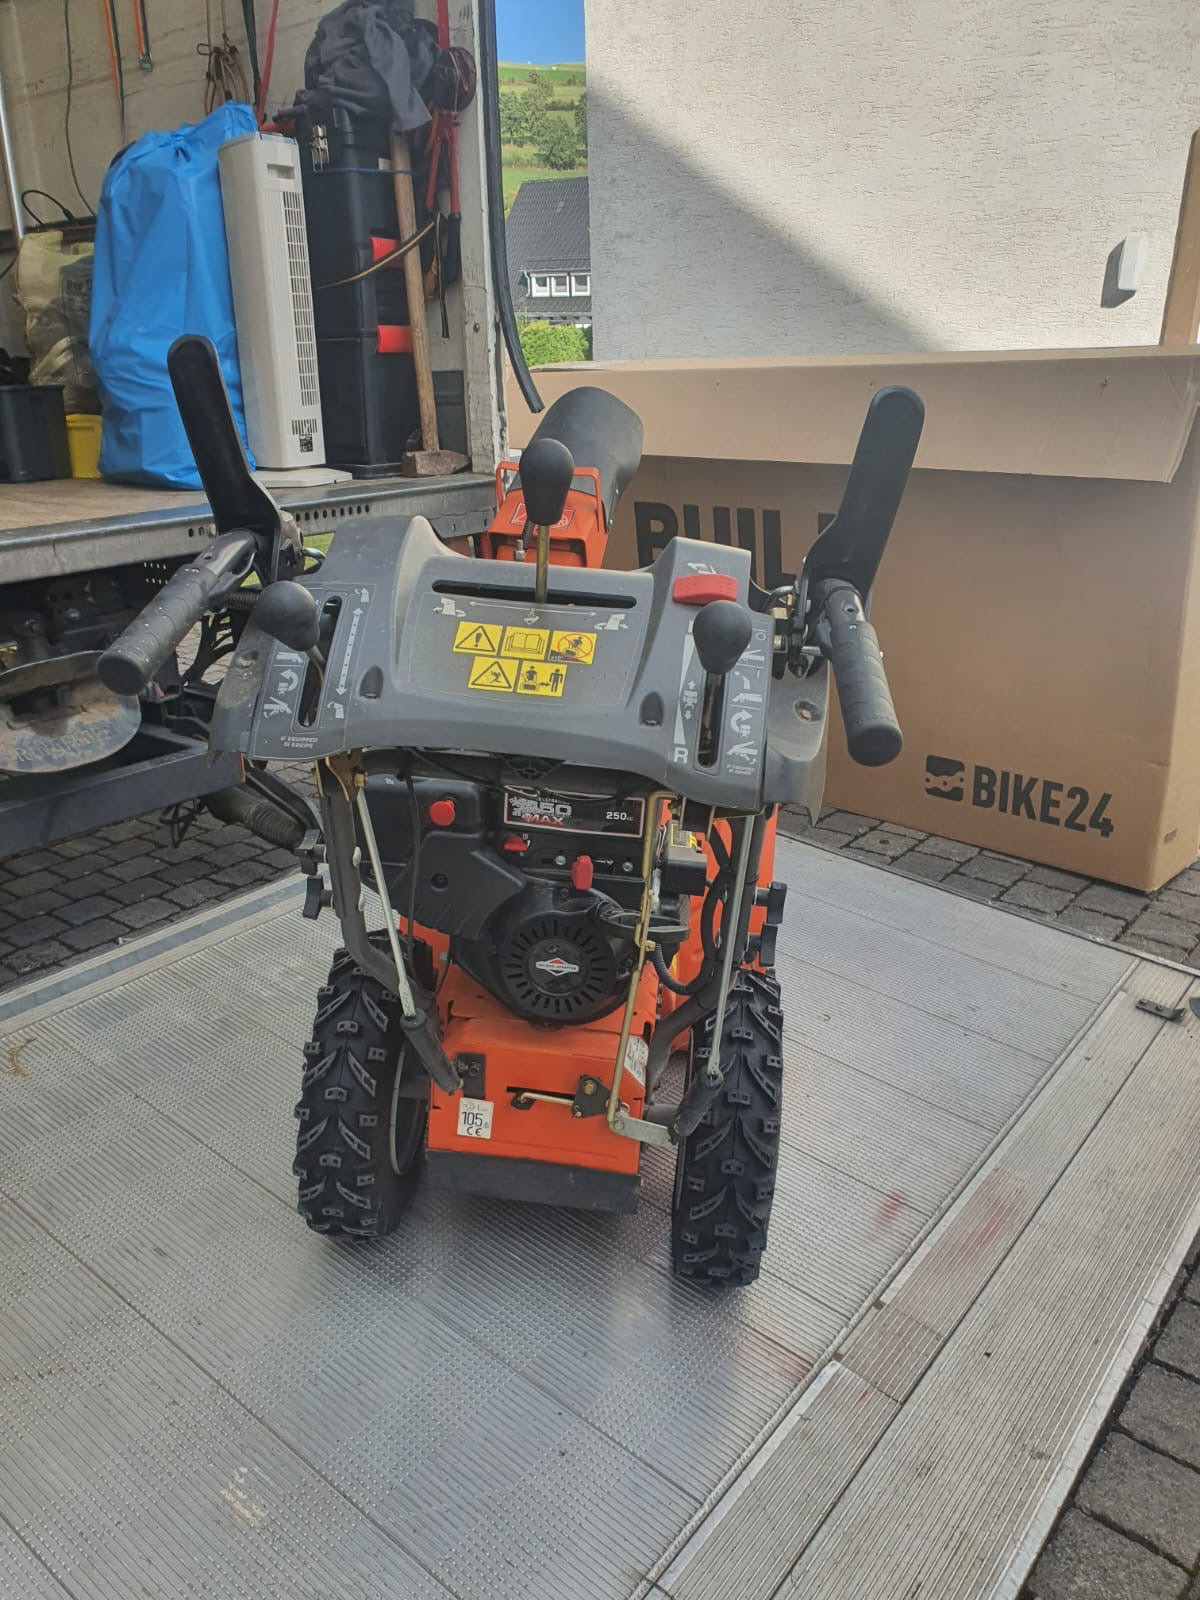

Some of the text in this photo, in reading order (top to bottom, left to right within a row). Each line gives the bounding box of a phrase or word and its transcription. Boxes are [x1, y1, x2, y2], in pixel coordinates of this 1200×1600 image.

[673, 747, 689, 764] R
[972, 765, 1114, 838] BIKE24
[462, 1112, 483, 1127] 105
